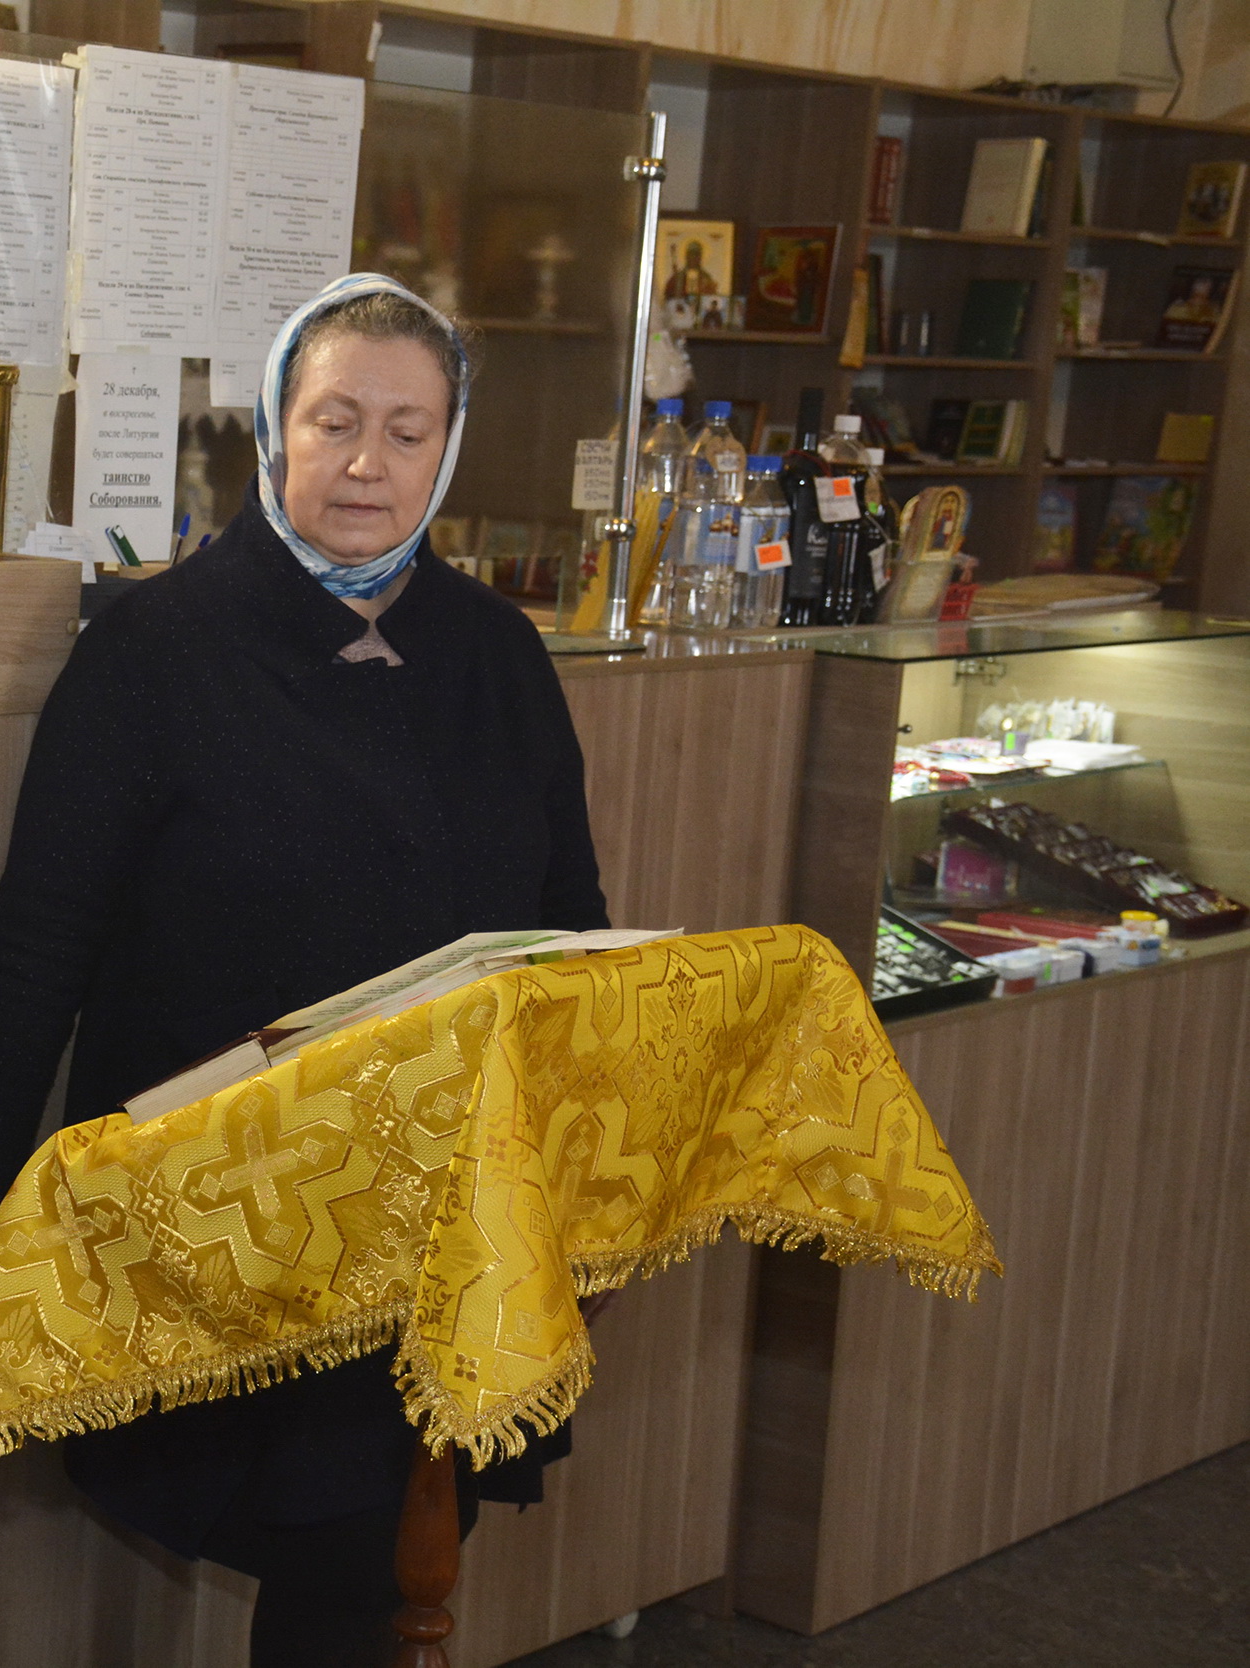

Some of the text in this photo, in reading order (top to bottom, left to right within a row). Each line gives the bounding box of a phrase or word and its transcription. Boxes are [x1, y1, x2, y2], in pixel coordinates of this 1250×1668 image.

[103, 382, 160, 400] 28 декабря,
[98, 428, 160, 441] после Литургии
[92, 448, 164, 461] будет совершаться
[103, 473, 150, 484] таинство
[90, 492, 162, 508] Соборования.
